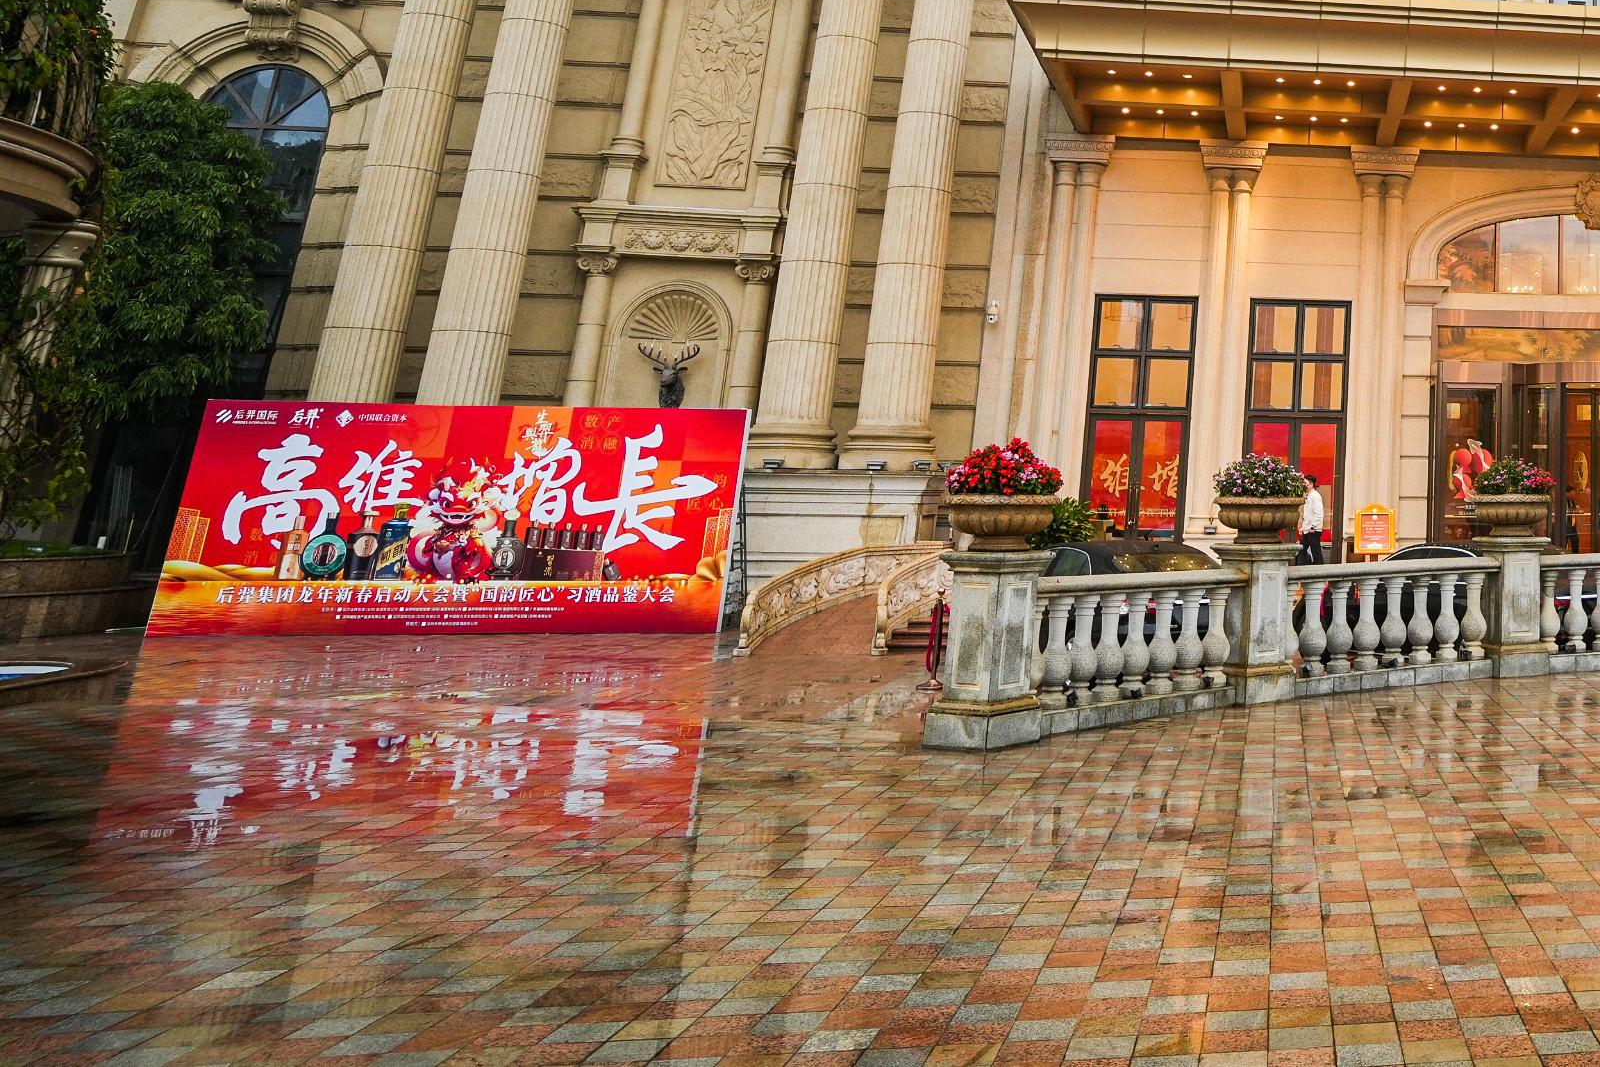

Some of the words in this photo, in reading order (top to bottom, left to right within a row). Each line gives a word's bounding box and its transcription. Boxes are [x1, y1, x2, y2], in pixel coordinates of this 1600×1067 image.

[233, 409, 279, 421] 后羿国际
[358, 414, 408, 423] 中国联合资本
